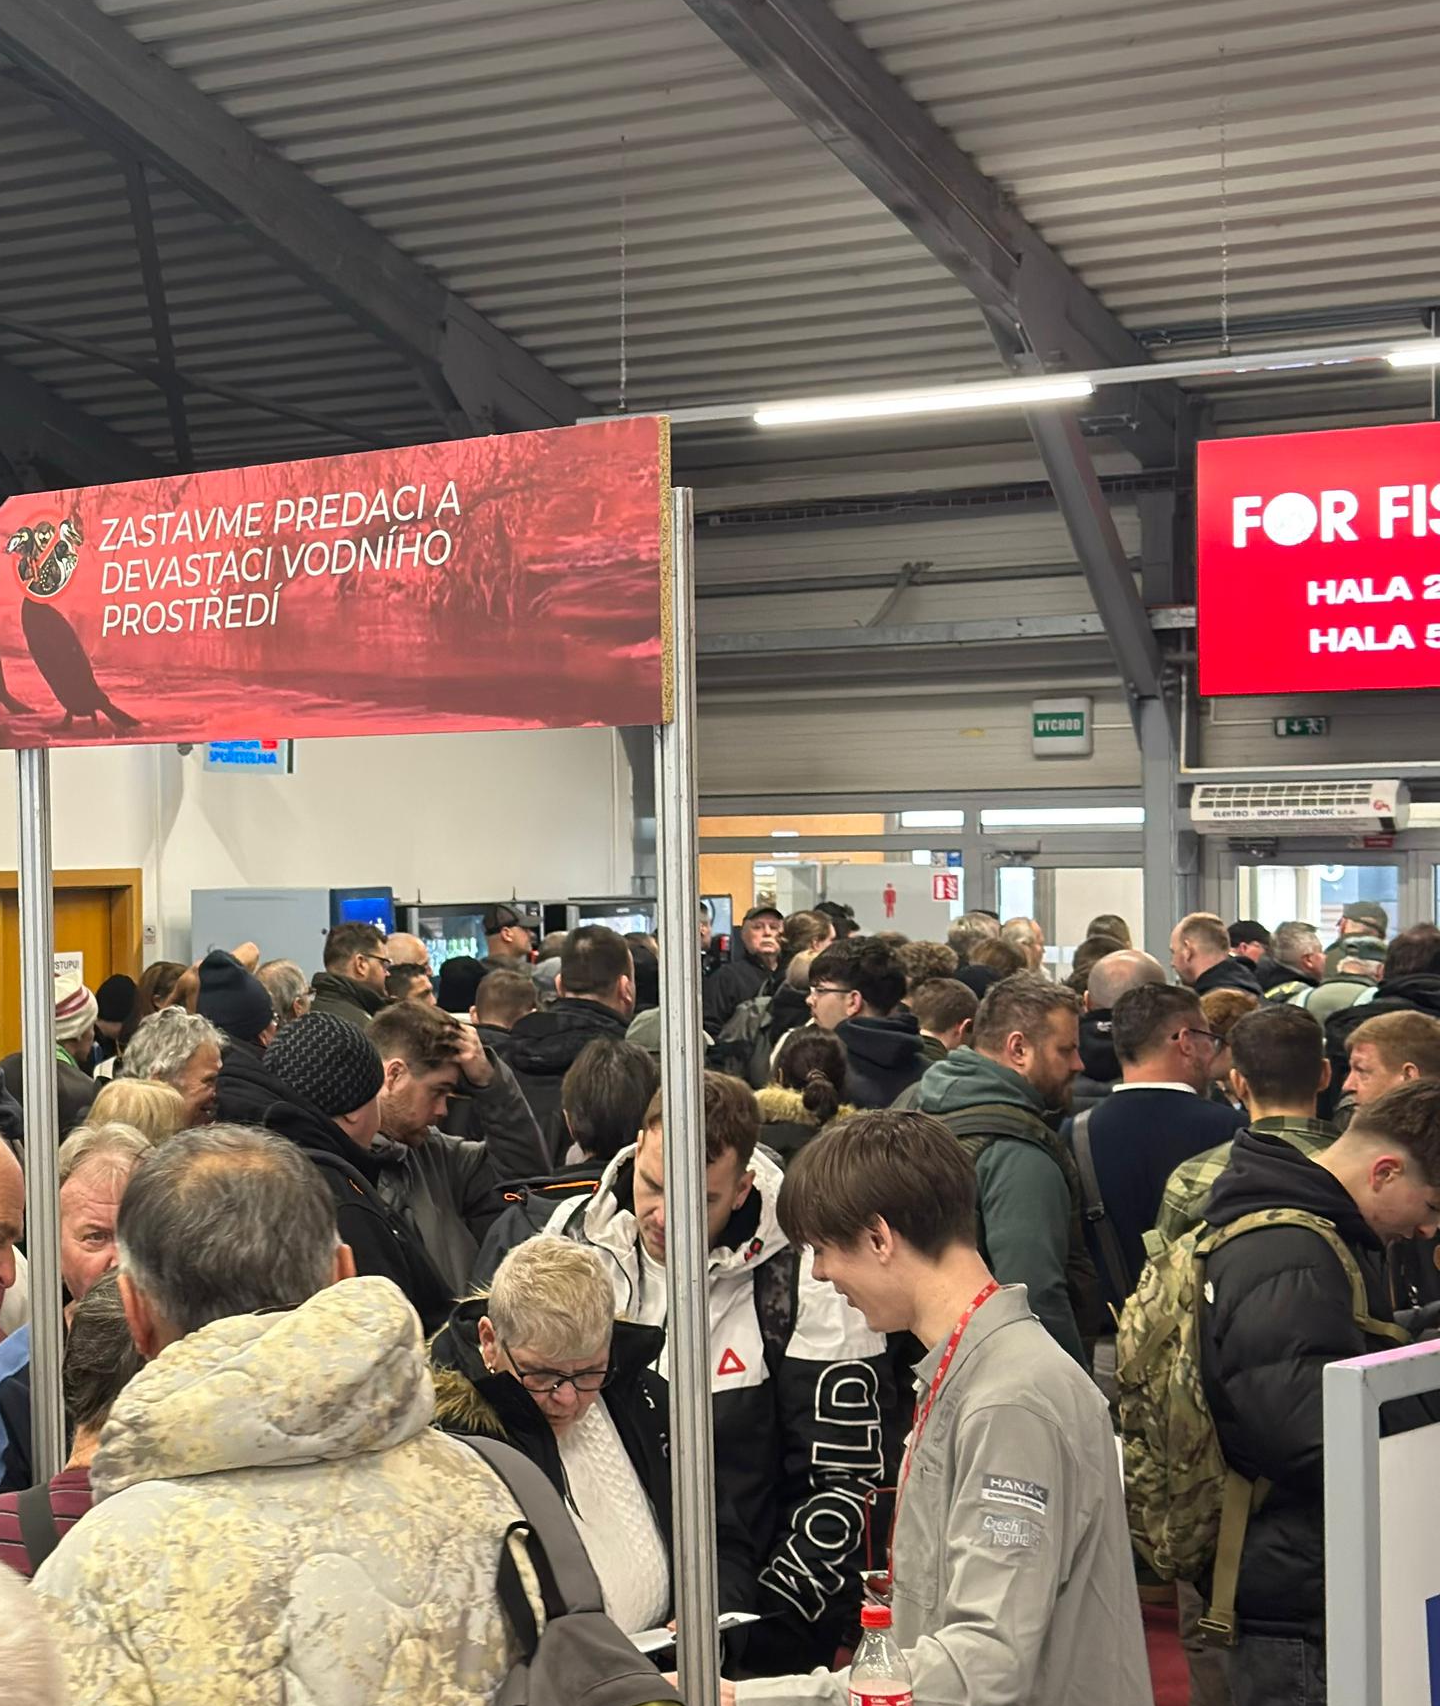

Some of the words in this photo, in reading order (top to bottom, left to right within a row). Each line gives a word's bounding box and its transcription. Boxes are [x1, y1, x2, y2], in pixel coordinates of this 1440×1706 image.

[98, 501, 264, 552] ZASTAVME
[273, 483, 427, 535] PREDACI
[434, 480, 461, 518] A
[1232, 489, 1359, 549] FOR
[101, 546, 272, 595] DEVASTACI
[282, 525, 453, 579] VODNÍHO
[102, 582, 283, 638] PROSTŘEDÍ
[1306, 576, 1414, 606] HALA
[1309, 624, 1416, 654] HALA
[990, 1478, 1045, 1500] HANÁK
[983, 1515, 1019, 1532] Czech
